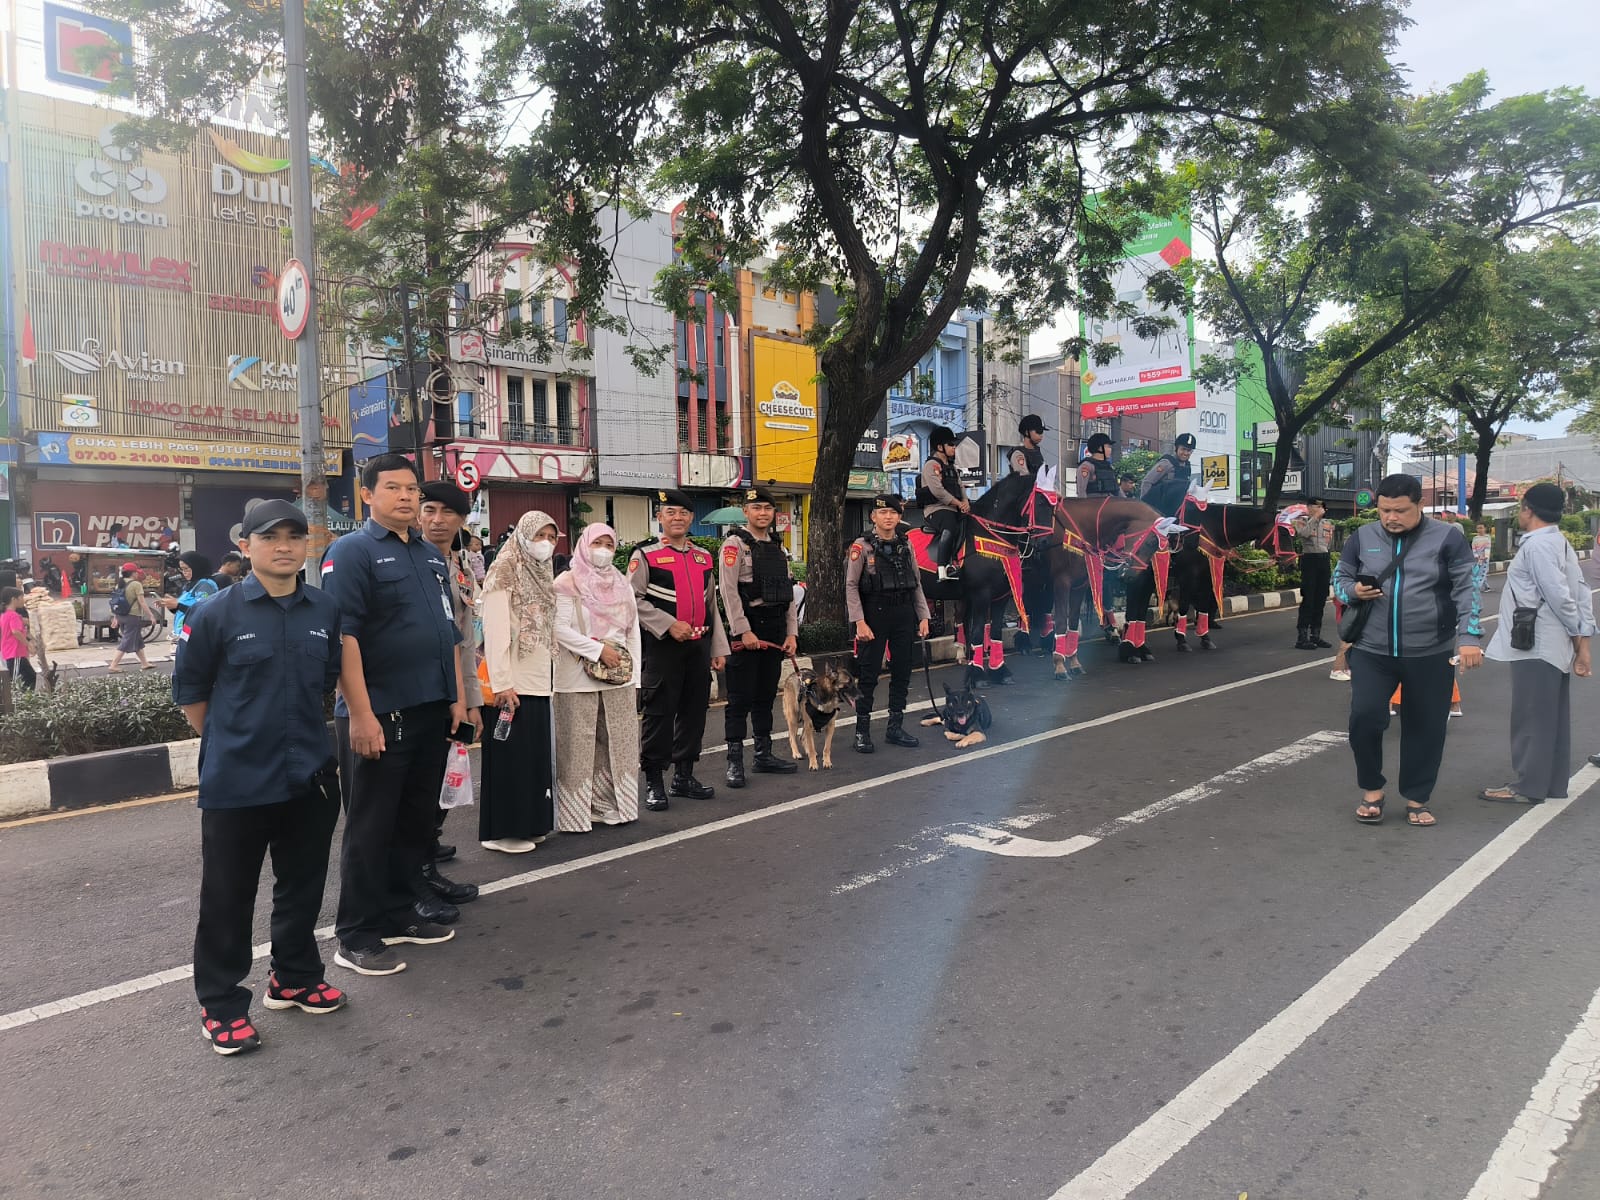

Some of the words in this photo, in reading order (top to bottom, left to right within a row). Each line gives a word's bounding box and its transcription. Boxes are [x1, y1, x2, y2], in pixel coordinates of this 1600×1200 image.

[76, 200, 167, 227] propan
[284, 285, 296, 316] 40
[103, 350, 185, 375] Avian
[127, 372, 164, 381] BRANDS
[262, 378, 297, 392] PAIN
[128, 400, 182, 416] TOKO
[189, 404, 225, 418] CAT
[231, 407, 299, 425] SELALU
[760, 402, 814, 416] CHEESECUIT
[74, 437, 117, 448] BUKA
[121, 440, 163, 450] LEBIH
[208, 445, 251, 454] TUTUP
[255, 447, 292, 457] LEBIH
[74, 450, 117, 461] 07.00
[130, 452, 170, 464] 21.00
[172, 455, 200, 465] WIB
[463, 466, 474, 485] S
[1205, 468, 1226, 478] Lois
[87, 515, 180, 531] NIPPON
[327, 521, 351, 531] ELALU
